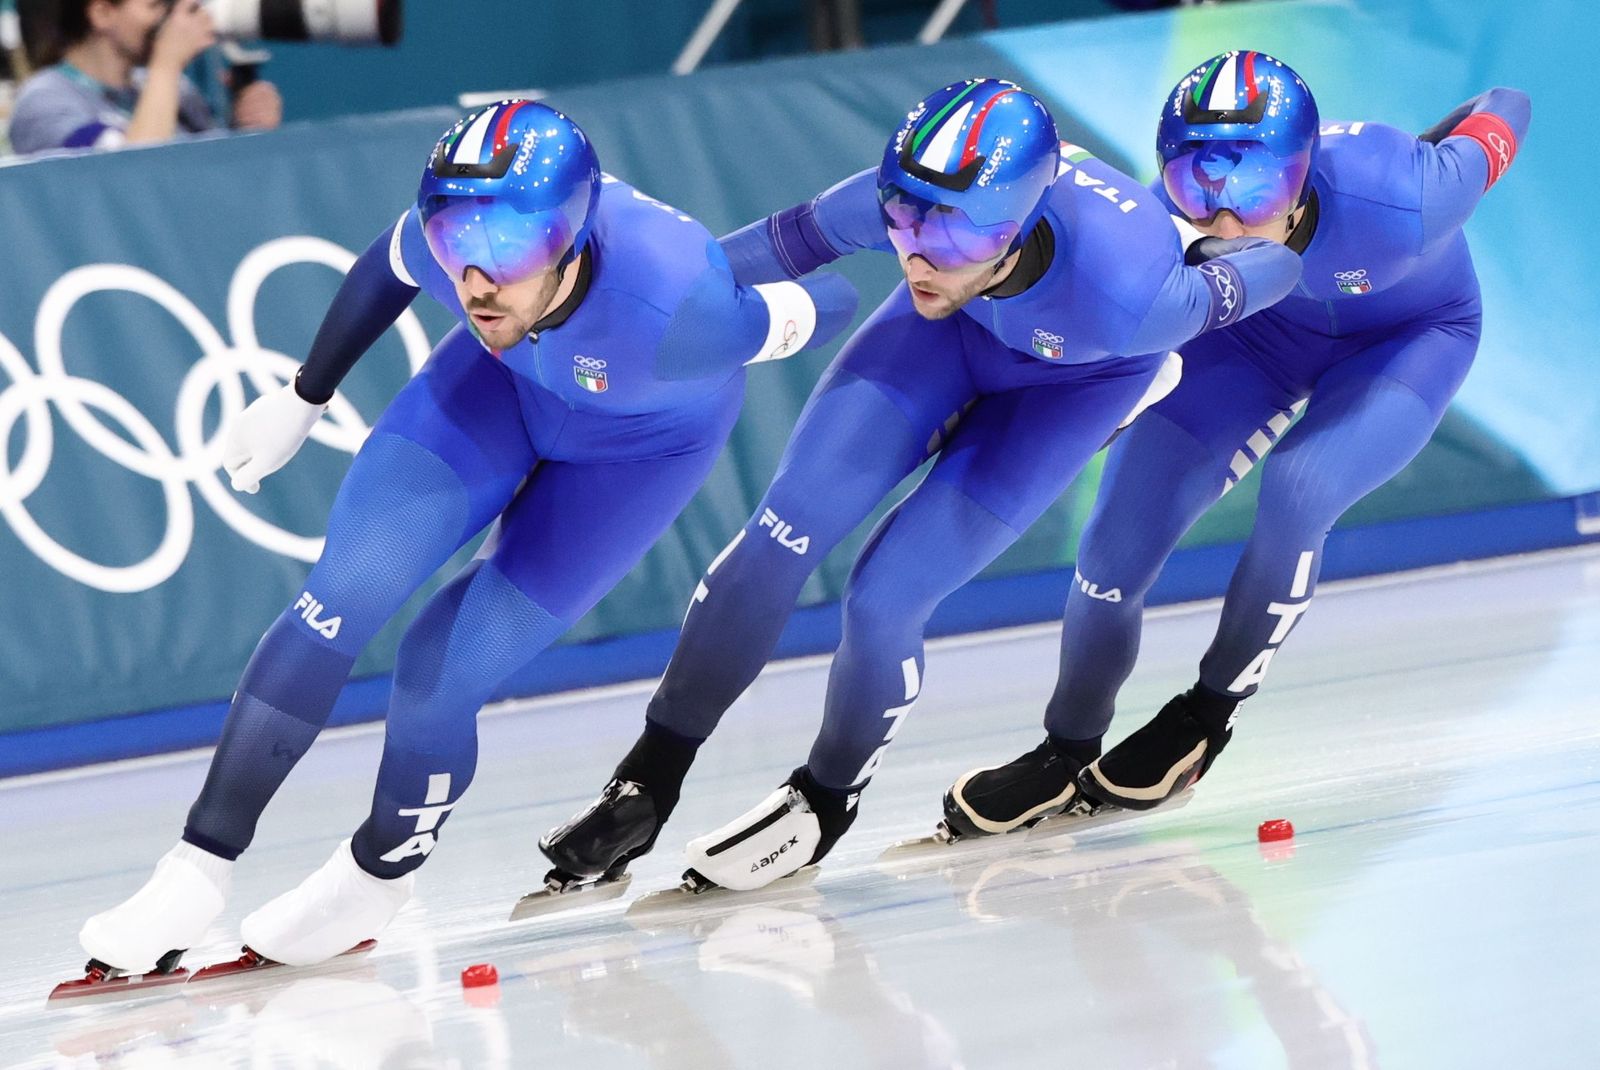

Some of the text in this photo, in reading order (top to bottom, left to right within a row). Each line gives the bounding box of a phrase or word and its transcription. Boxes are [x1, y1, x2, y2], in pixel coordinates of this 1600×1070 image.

[512, 128, 538, 176] RUDY
[976, 136, 1007, 187] RUDY
[576, 367, 605, 379] ITALIA
[758, 507, 810, 555] FILA
[293, 590, 342, 640] FILA
[760, 834, 799, 868] apex
